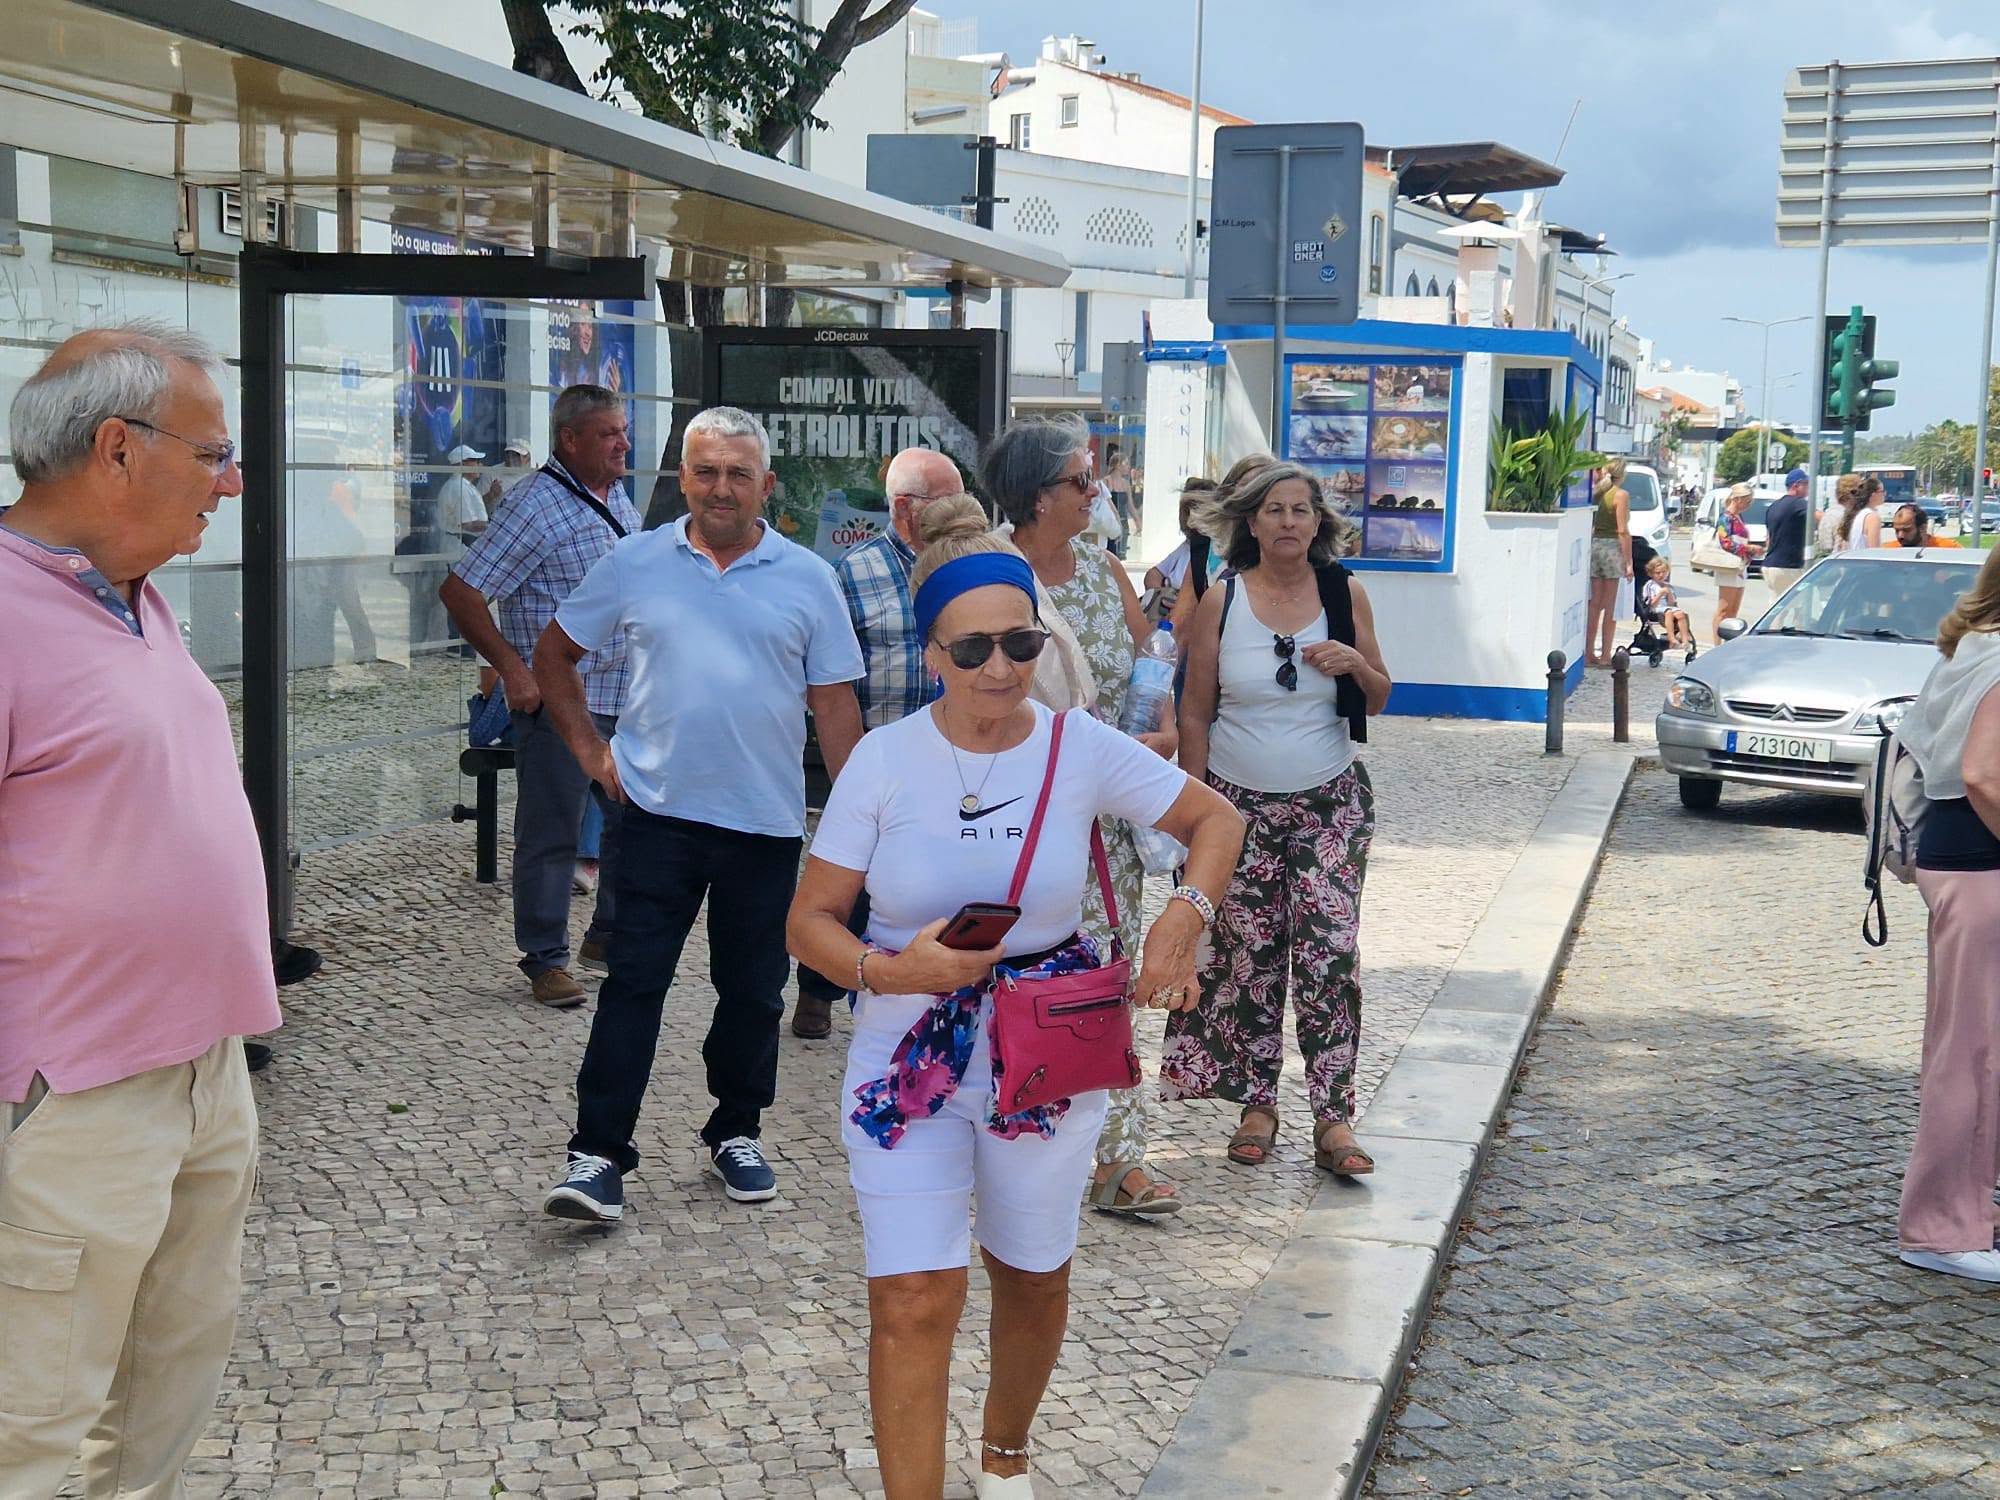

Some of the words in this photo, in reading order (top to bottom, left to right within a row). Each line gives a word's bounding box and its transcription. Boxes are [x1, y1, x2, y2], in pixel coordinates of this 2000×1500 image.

[814, 331, 869, 342] JCDecaux
[779, 377, 857, 405] COMPAL
[862, 377, 916, 406] VITAL
[753, 405, 961, 458] ETRÓLITOS+
[1748, 736, 1816, 759] 2131QN
[960, 827, 1024, 840] AIR
